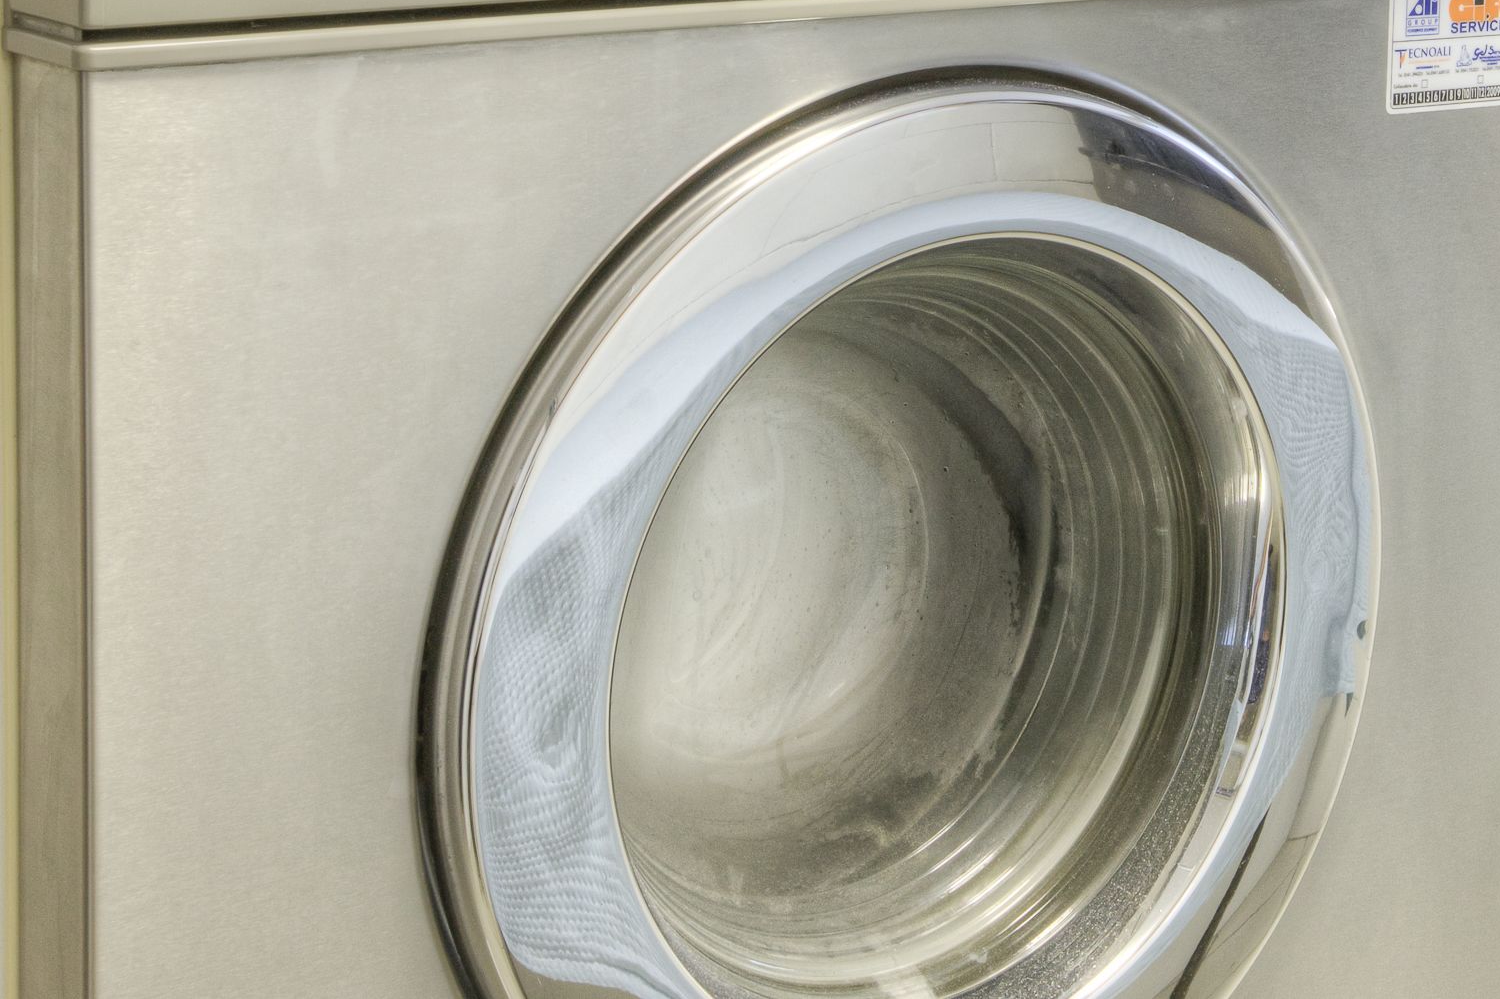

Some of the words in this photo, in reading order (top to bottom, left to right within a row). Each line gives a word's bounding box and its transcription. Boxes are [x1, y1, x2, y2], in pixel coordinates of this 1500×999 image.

[1408, 19, 1438, 27] GROUP
[1463, 88, 1470, 99] 10
[1471, 87, 1477, 98] 11
[1479, 87, 1485, 98] 12
[1487, 87, 1500, 97] 2009
